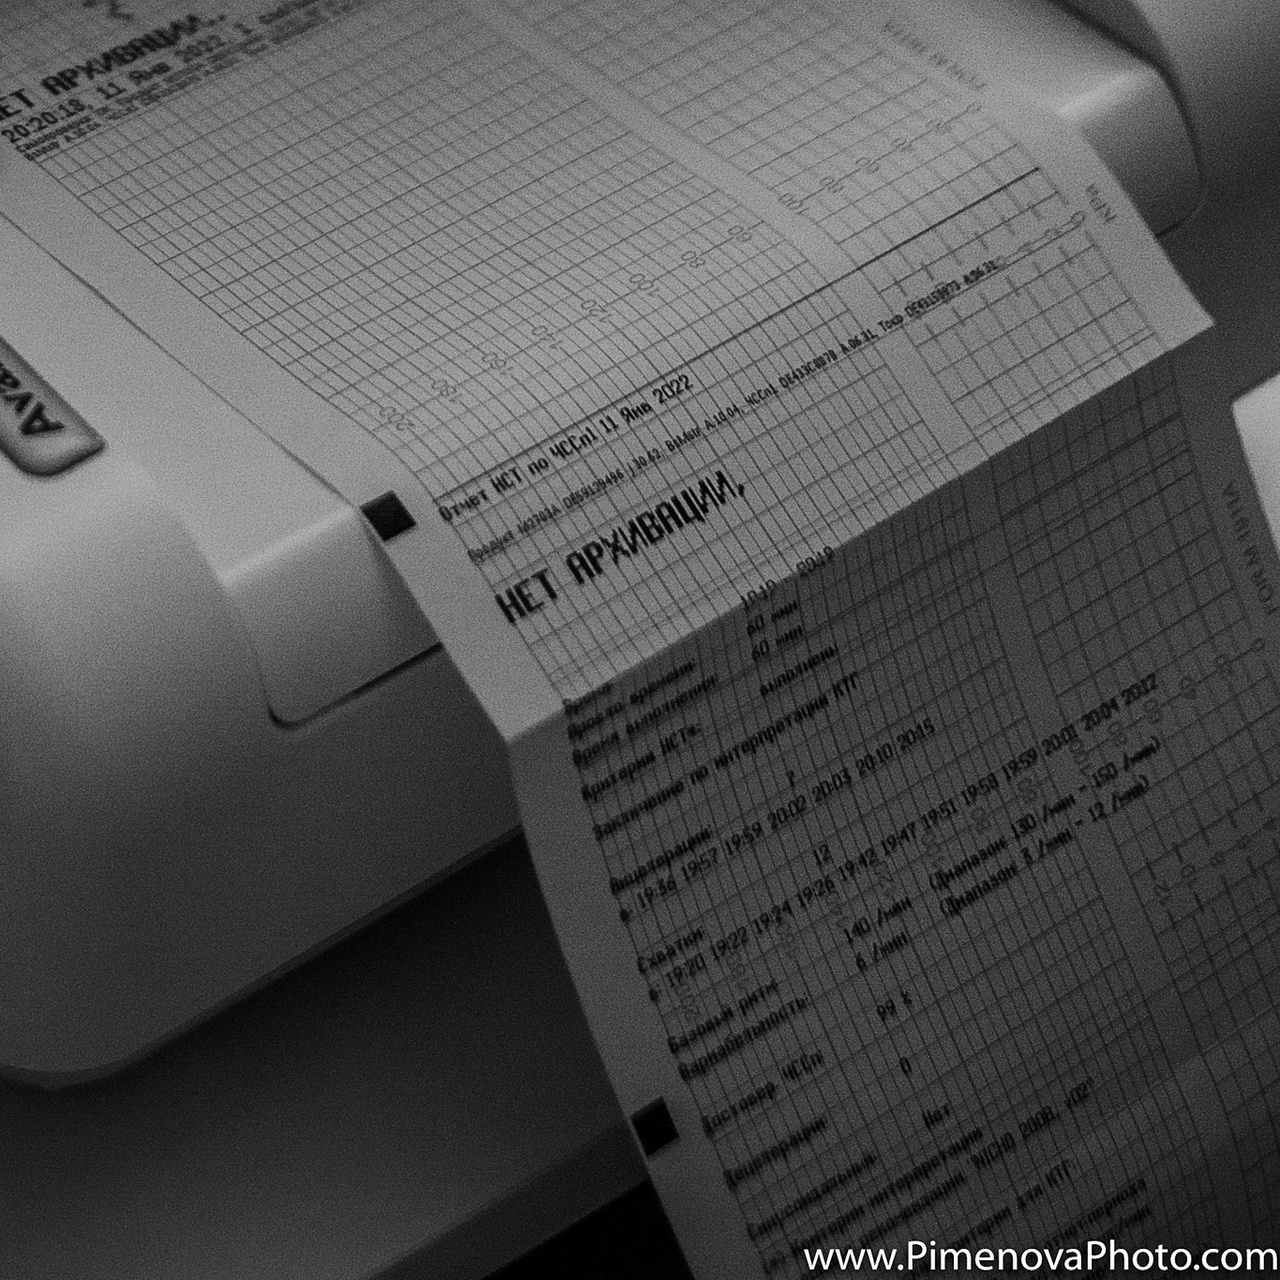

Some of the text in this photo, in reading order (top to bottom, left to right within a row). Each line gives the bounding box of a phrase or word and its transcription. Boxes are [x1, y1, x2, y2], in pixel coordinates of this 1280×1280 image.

[95, 80, 126, 99] 11
[439, 371, 693, 526] Отчет НСТ по ЧССп1 11 Янв 2022
[494, 470, 746, 625] НЕТ АРХИВАЦИИ,
[746, 615, 766, 636] 60
[750, 639, 771, 661] 60
[689, 764, 709, 783] по
[714, 694, 831, 774] интерпретации
[581, 748, 658, 807] Критерии
[681, 848, 720, 880] 19:57
[725, 821, 764, 853] 19:59
[766, 795, 808, 830] 20:02
[811, 768, 852, 803] 20:03
[854, 743, 893, 775] 20:10
[897, 718, 935, 750] 20:15
[666, 953, 706, 987] 19:20
[710, 927, 749, 961] 19:22
[755, 901, 793, 934] 19:24
[797, 873, 837, 909] 19:26
[839, 847, 878, 881] 19:42
[882, 824, 919, 856] 19:47
[923, 799, 958, 830] 19:51
[962, 773, 999, 806] 19:58
[1003, 749, 1039, 780] 19:59
[1043, 724, 1079, 756] 20:01
[1082, 698, 1120, 731] 20:04
[1122, 673, 1160, 706] 20:12
[1087, 800, 1107, 822] 12
[814, 844, 832, 865] 12
[844, 917, 872, 944] 140
[1011, 813, 1037, 839] 130
[1092, 763, 1118, 788] 150
[875, 999, 897, 1023] 99
